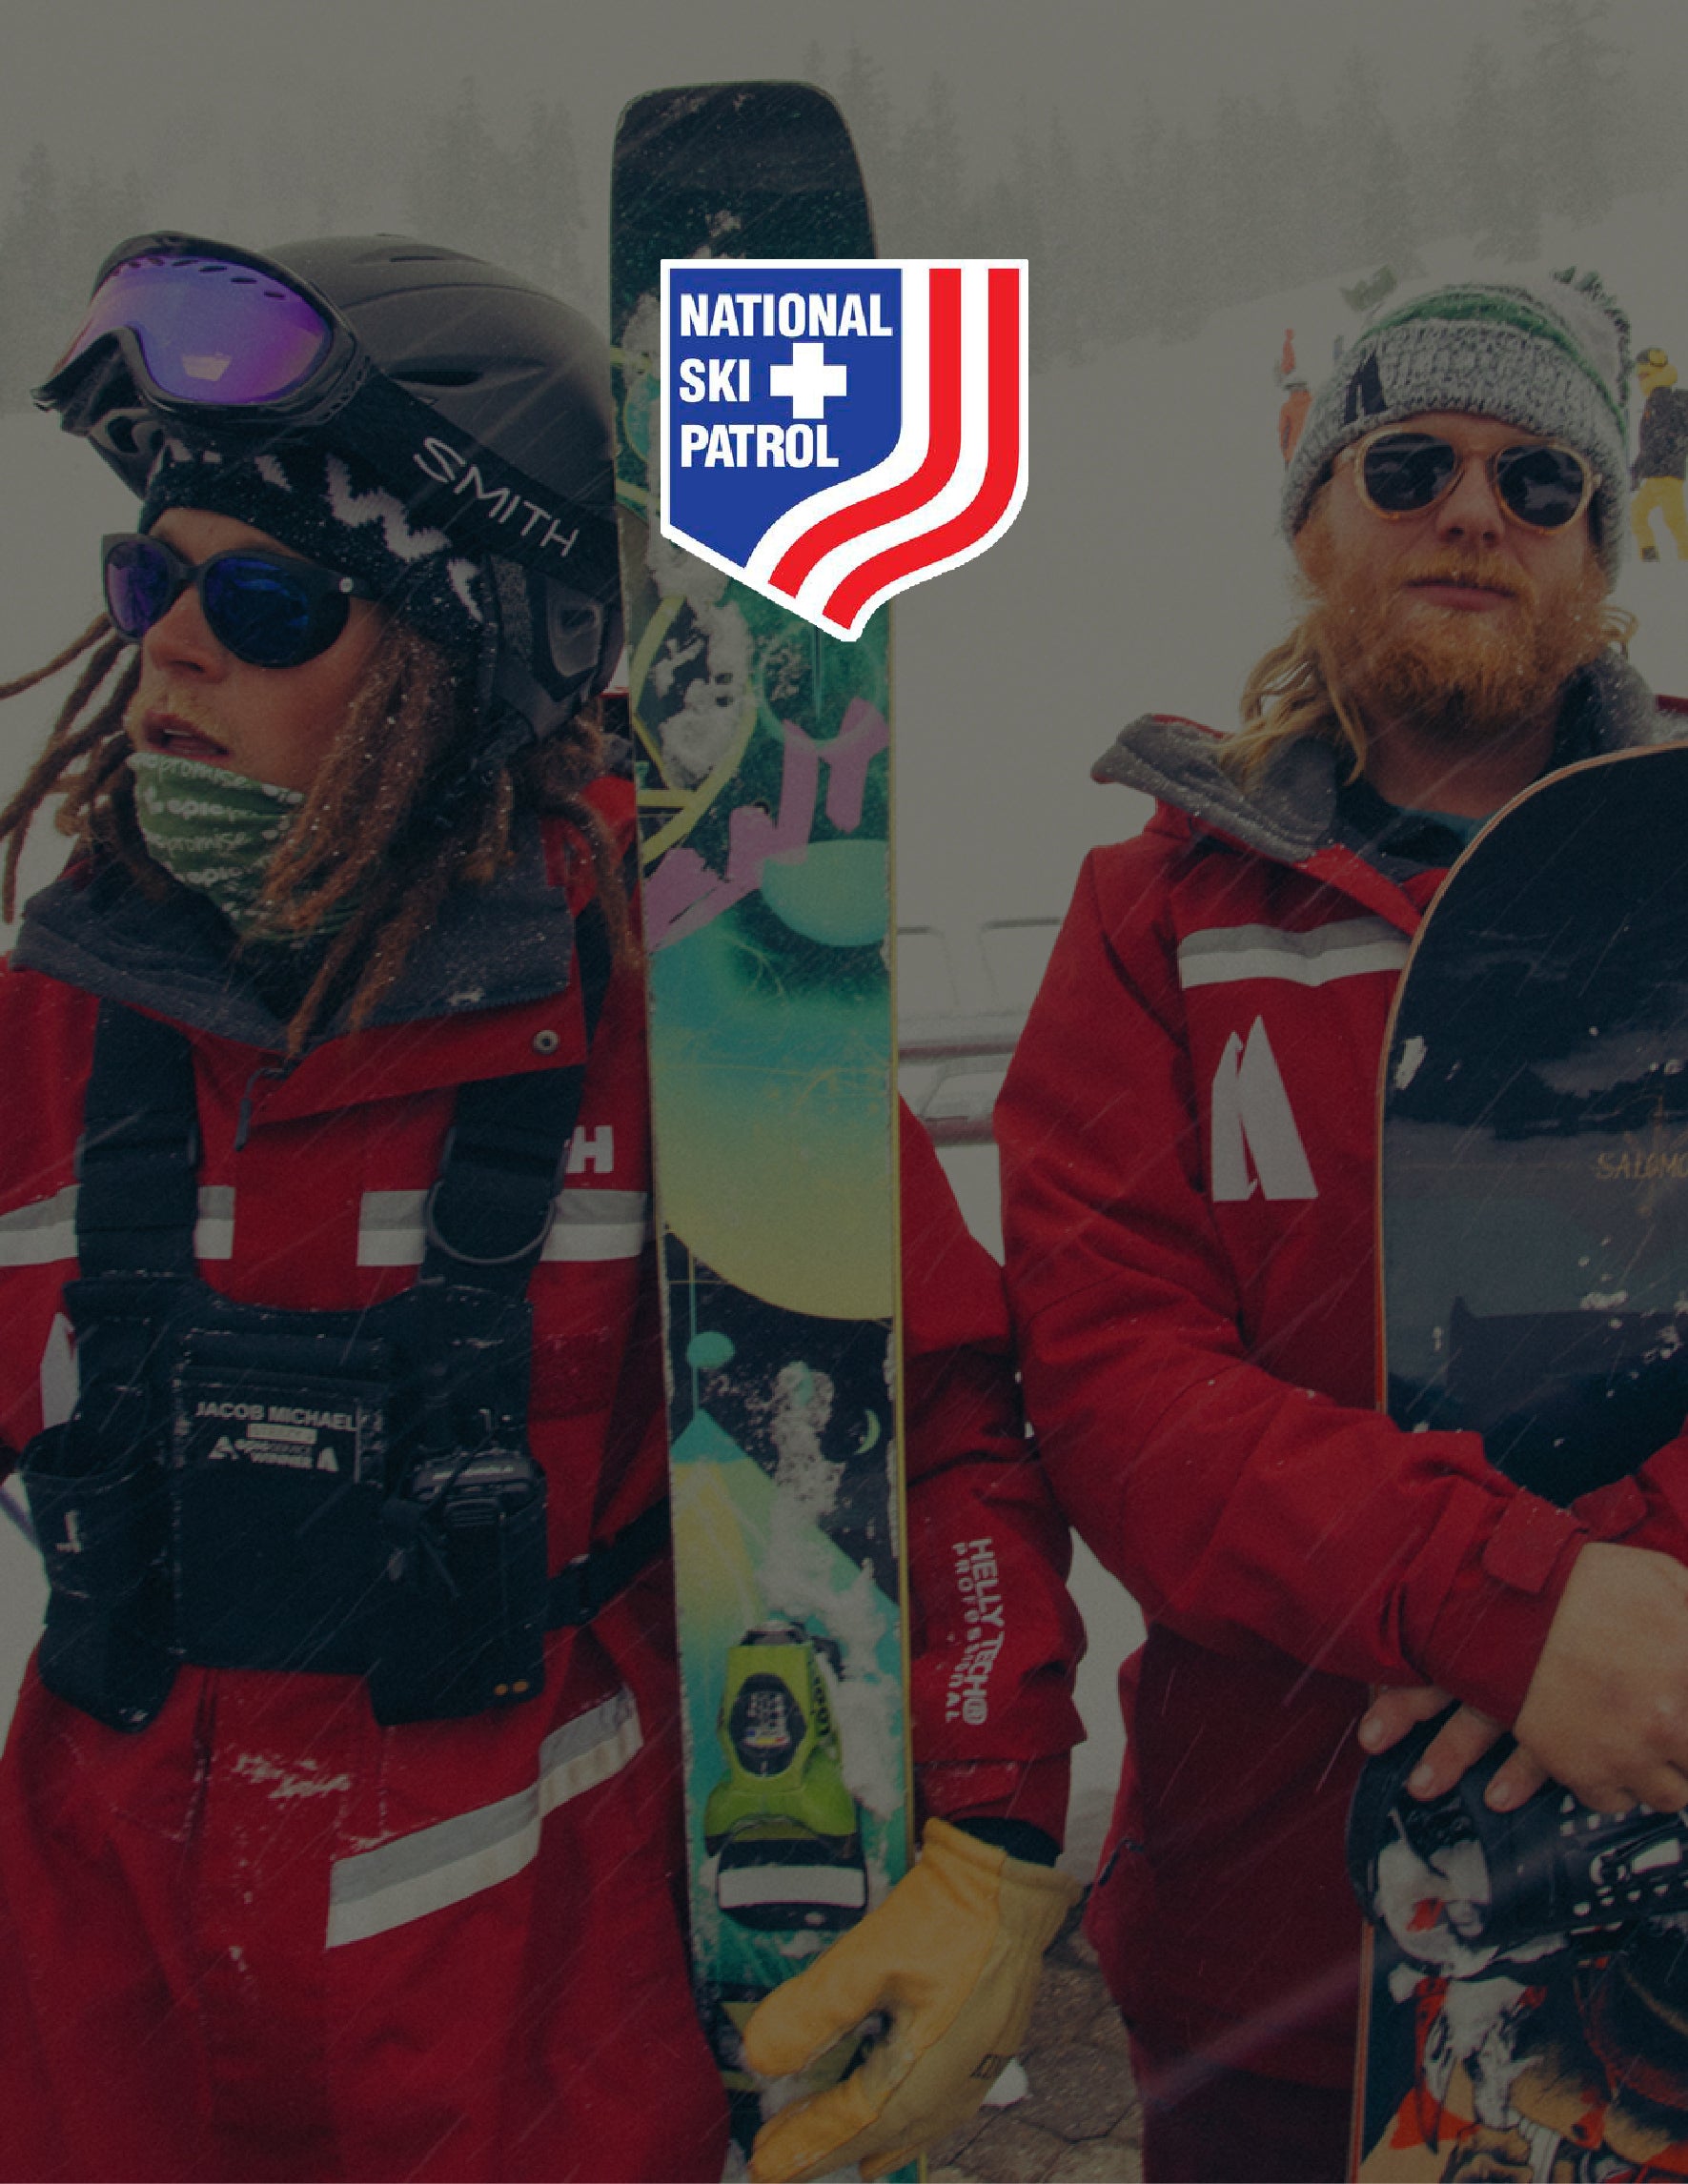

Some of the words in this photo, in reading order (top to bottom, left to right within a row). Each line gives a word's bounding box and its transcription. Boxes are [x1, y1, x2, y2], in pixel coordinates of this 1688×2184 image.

[413, 436, 580, 557] SMITH
[195, 1402, 264, 1421] JACOB
[968, 1537, 1005, 1628] HELLY
